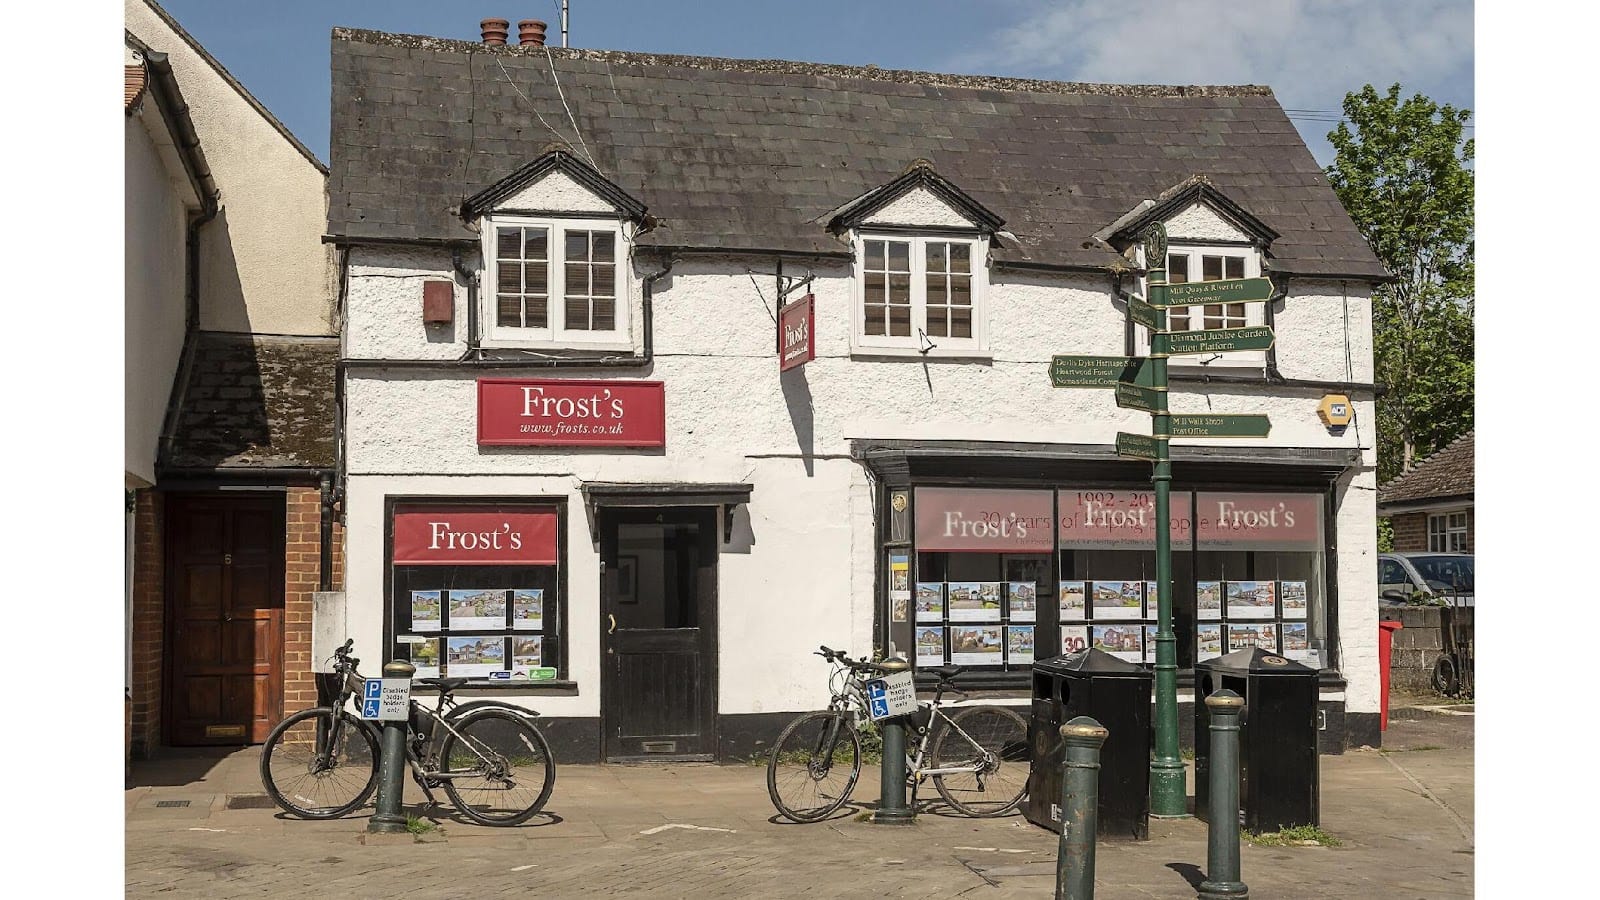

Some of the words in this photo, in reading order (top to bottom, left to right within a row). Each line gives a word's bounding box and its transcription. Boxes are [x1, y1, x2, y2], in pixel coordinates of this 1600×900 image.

[1170, 333, 1207, 342] Diamond
[1207, 331, 1236, 341] Jubilee
[1237, 329, 1268, 338] Garden
[1170, 344, 1197, 352] Station
[1200, 342, 1235, 351] Platform
[1093, 368, 1113, 376] Forest
[519, 386, 625, 419] Frost's
[519, 421, 625, 437] www.frosts.co.uk
[1187, 427, 1209, 435] Office
[1076, 491, 1115, 507] 1992
[1061, 511, 1078, 530] of
[1083, 500, 1155, 527] Frost'
[1217, 501, 1296, 528] Frost's
[943, 511, 1028, 539] Frost's
[427, 522, 523, 550] Frost's
[223, 553, 232, 566] 6
[1064, 637, 1086, 653] 30
[369, 682, 380, 697] P
